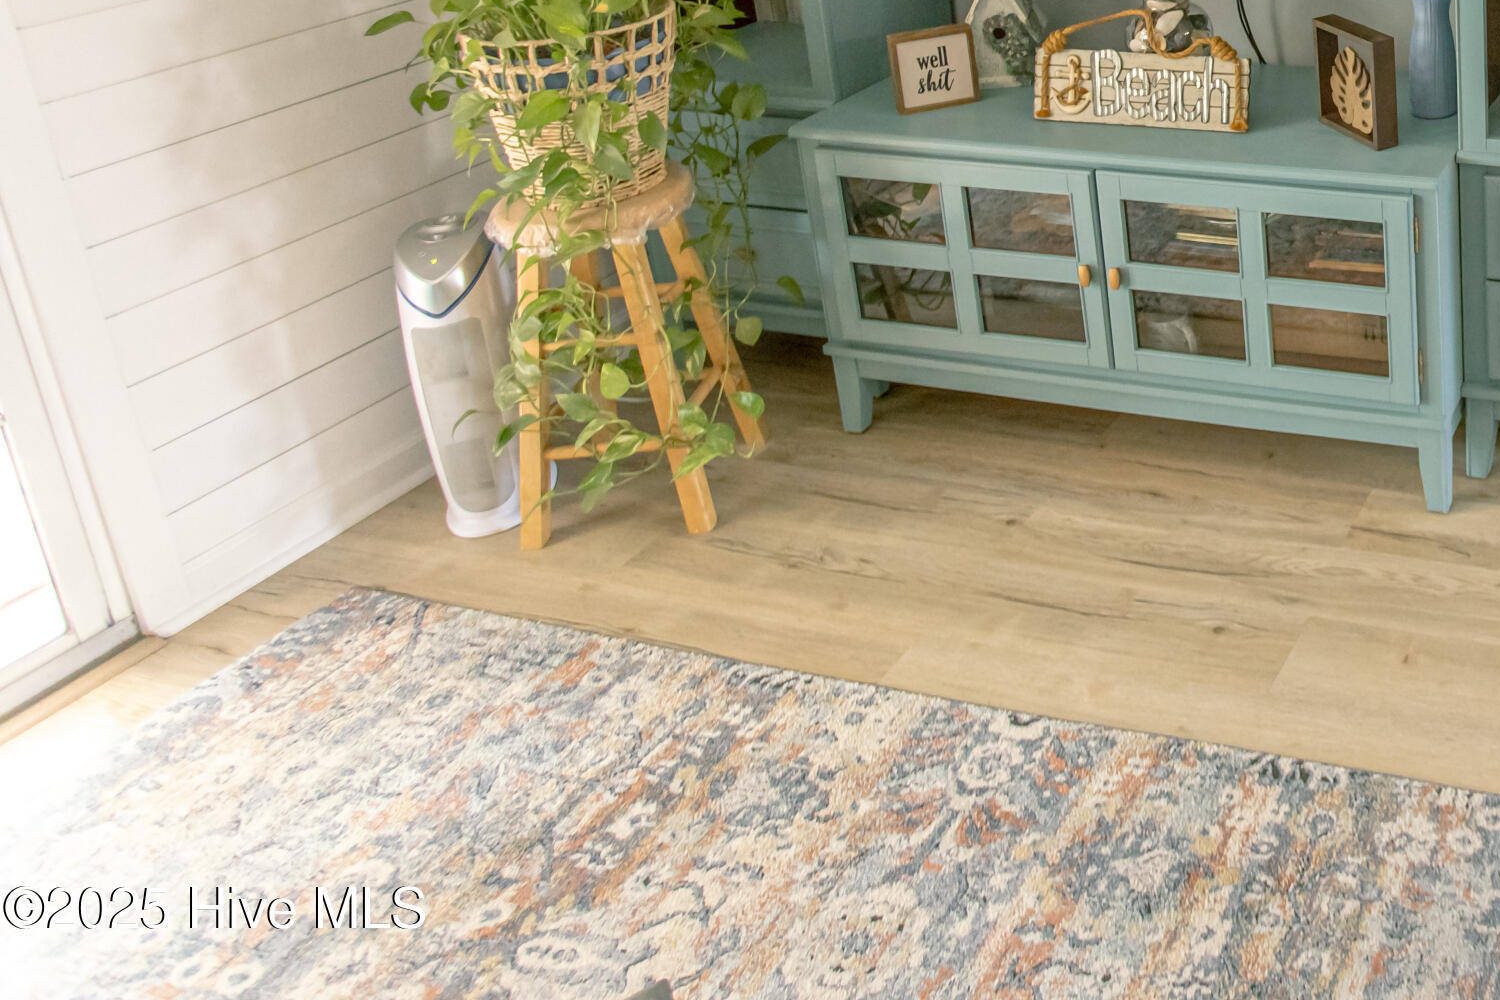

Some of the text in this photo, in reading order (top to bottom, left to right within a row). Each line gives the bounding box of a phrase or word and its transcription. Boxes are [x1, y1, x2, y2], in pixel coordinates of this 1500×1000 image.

[916, 45, 949, 71] well
[918, 68, 957, 94] shit
[1090, 48, 1230, 125] Beach
